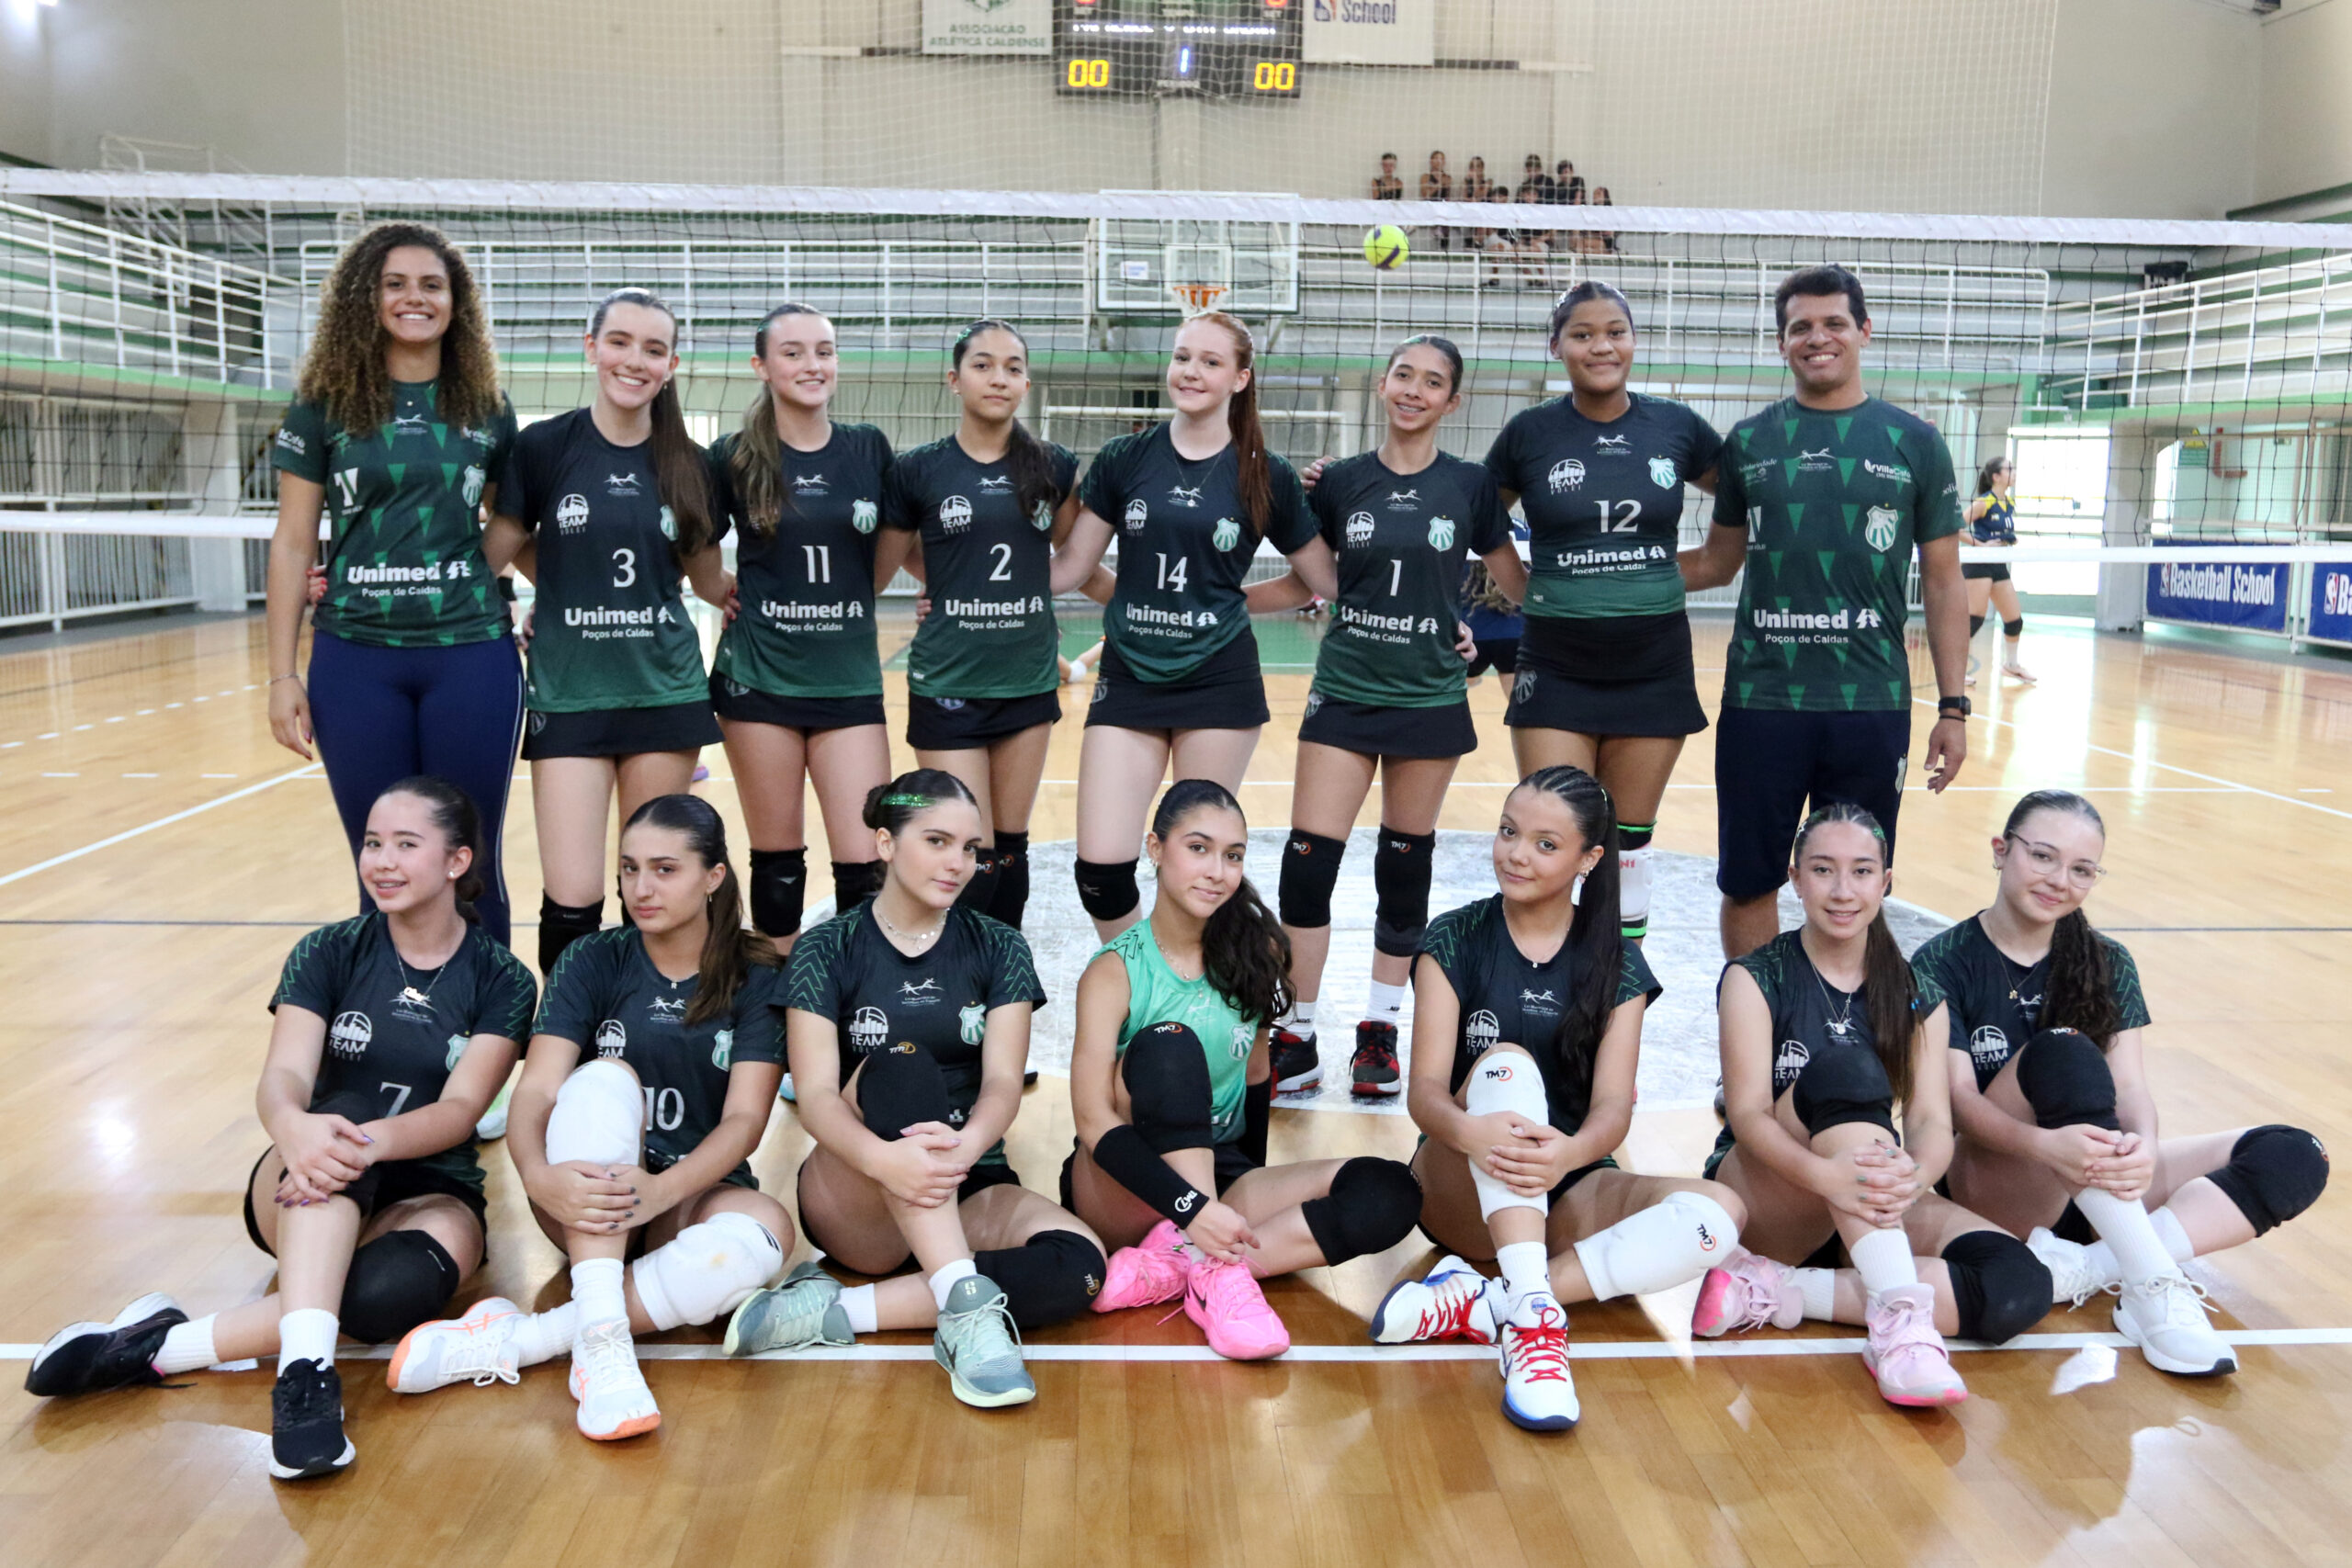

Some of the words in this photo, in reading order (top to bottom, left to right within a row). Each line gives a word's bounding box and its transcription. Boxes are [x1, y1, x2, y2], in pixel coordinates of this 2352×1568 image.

[1341, 0, 1396, 24] School
[1068, 60, 1109, 87] 00
[1254, 62, 1295, 90] 00
[1551, 476, 1584, 490] TEAM
[559, 516, 586, 528] TEAM
[943, 515, 970, 528] TEAM
[1594, 500, 1642, 533] 12
[801, 546, 831, 583] 11
[989, 543, 1012, 581] 2
[1557, 547, 1646, 567] Unimed
[347, 561, 440, 584] Unimed
[612, 548, 636, 588] 3
[1156, 553, 1188, 592] 14
[1390, 559, 1401, 596] 1
[393, 587, 405, 596] de
[409, 586, 441, 595] Caldas
[2170, 563, 2232, 603] Basketball
[2233, 565, 2276, 605] School
[565, 606, 653, 626] Unimed
[762, 601, 842, 618] Unimed
[945, 598, 1025, 616] Unimed
[1126, 603, 1193, 626] Unimed
[775, 622, 801, 632] Poços
[803, 623, 813, 631] de
[816, 623, 842, 631] Caldas
[959, 620, 984, 631] Poços
[986, 620, 997, 628] de
[999, 620, 1024, 628] Caldas
[1341, 605, 1413, 632] Unimed
[1754, 608, 1849, 629] Unimed
[582, 629, 610, 640] Poços
[612, 629, 624, 637] de
[625, 628, 654, 637] Caldas
[1129, 625, 1152, 636] Poços
[1154, 627, 1164, 636] de
[1166, 628, 1193, 638] Caldas
[1348, 626, 1369, 637] Poços
[1371, 631, 1381, 640] de
[1382, 633, 1410, 644] Caldas
[1765, 634, 1796, 644] Poços
[1798, 635, 1811, 643] de
[1814, 635, 1849, 644] Caldas
[329, 1038, 366, 1053] TEAM
[852, 1033, 886, 1045] TEAM
[1973, 1050, 2007, 1064] TEAM
[1486, 1070, 1507, 1079] TM7
[379, 1081, 412, 1117] 7
[642, 1087, 684, 1131] 10
[1178, 1190, 1198, 1210] TM7
[1696, 1224, 1713, 1247] TM7
